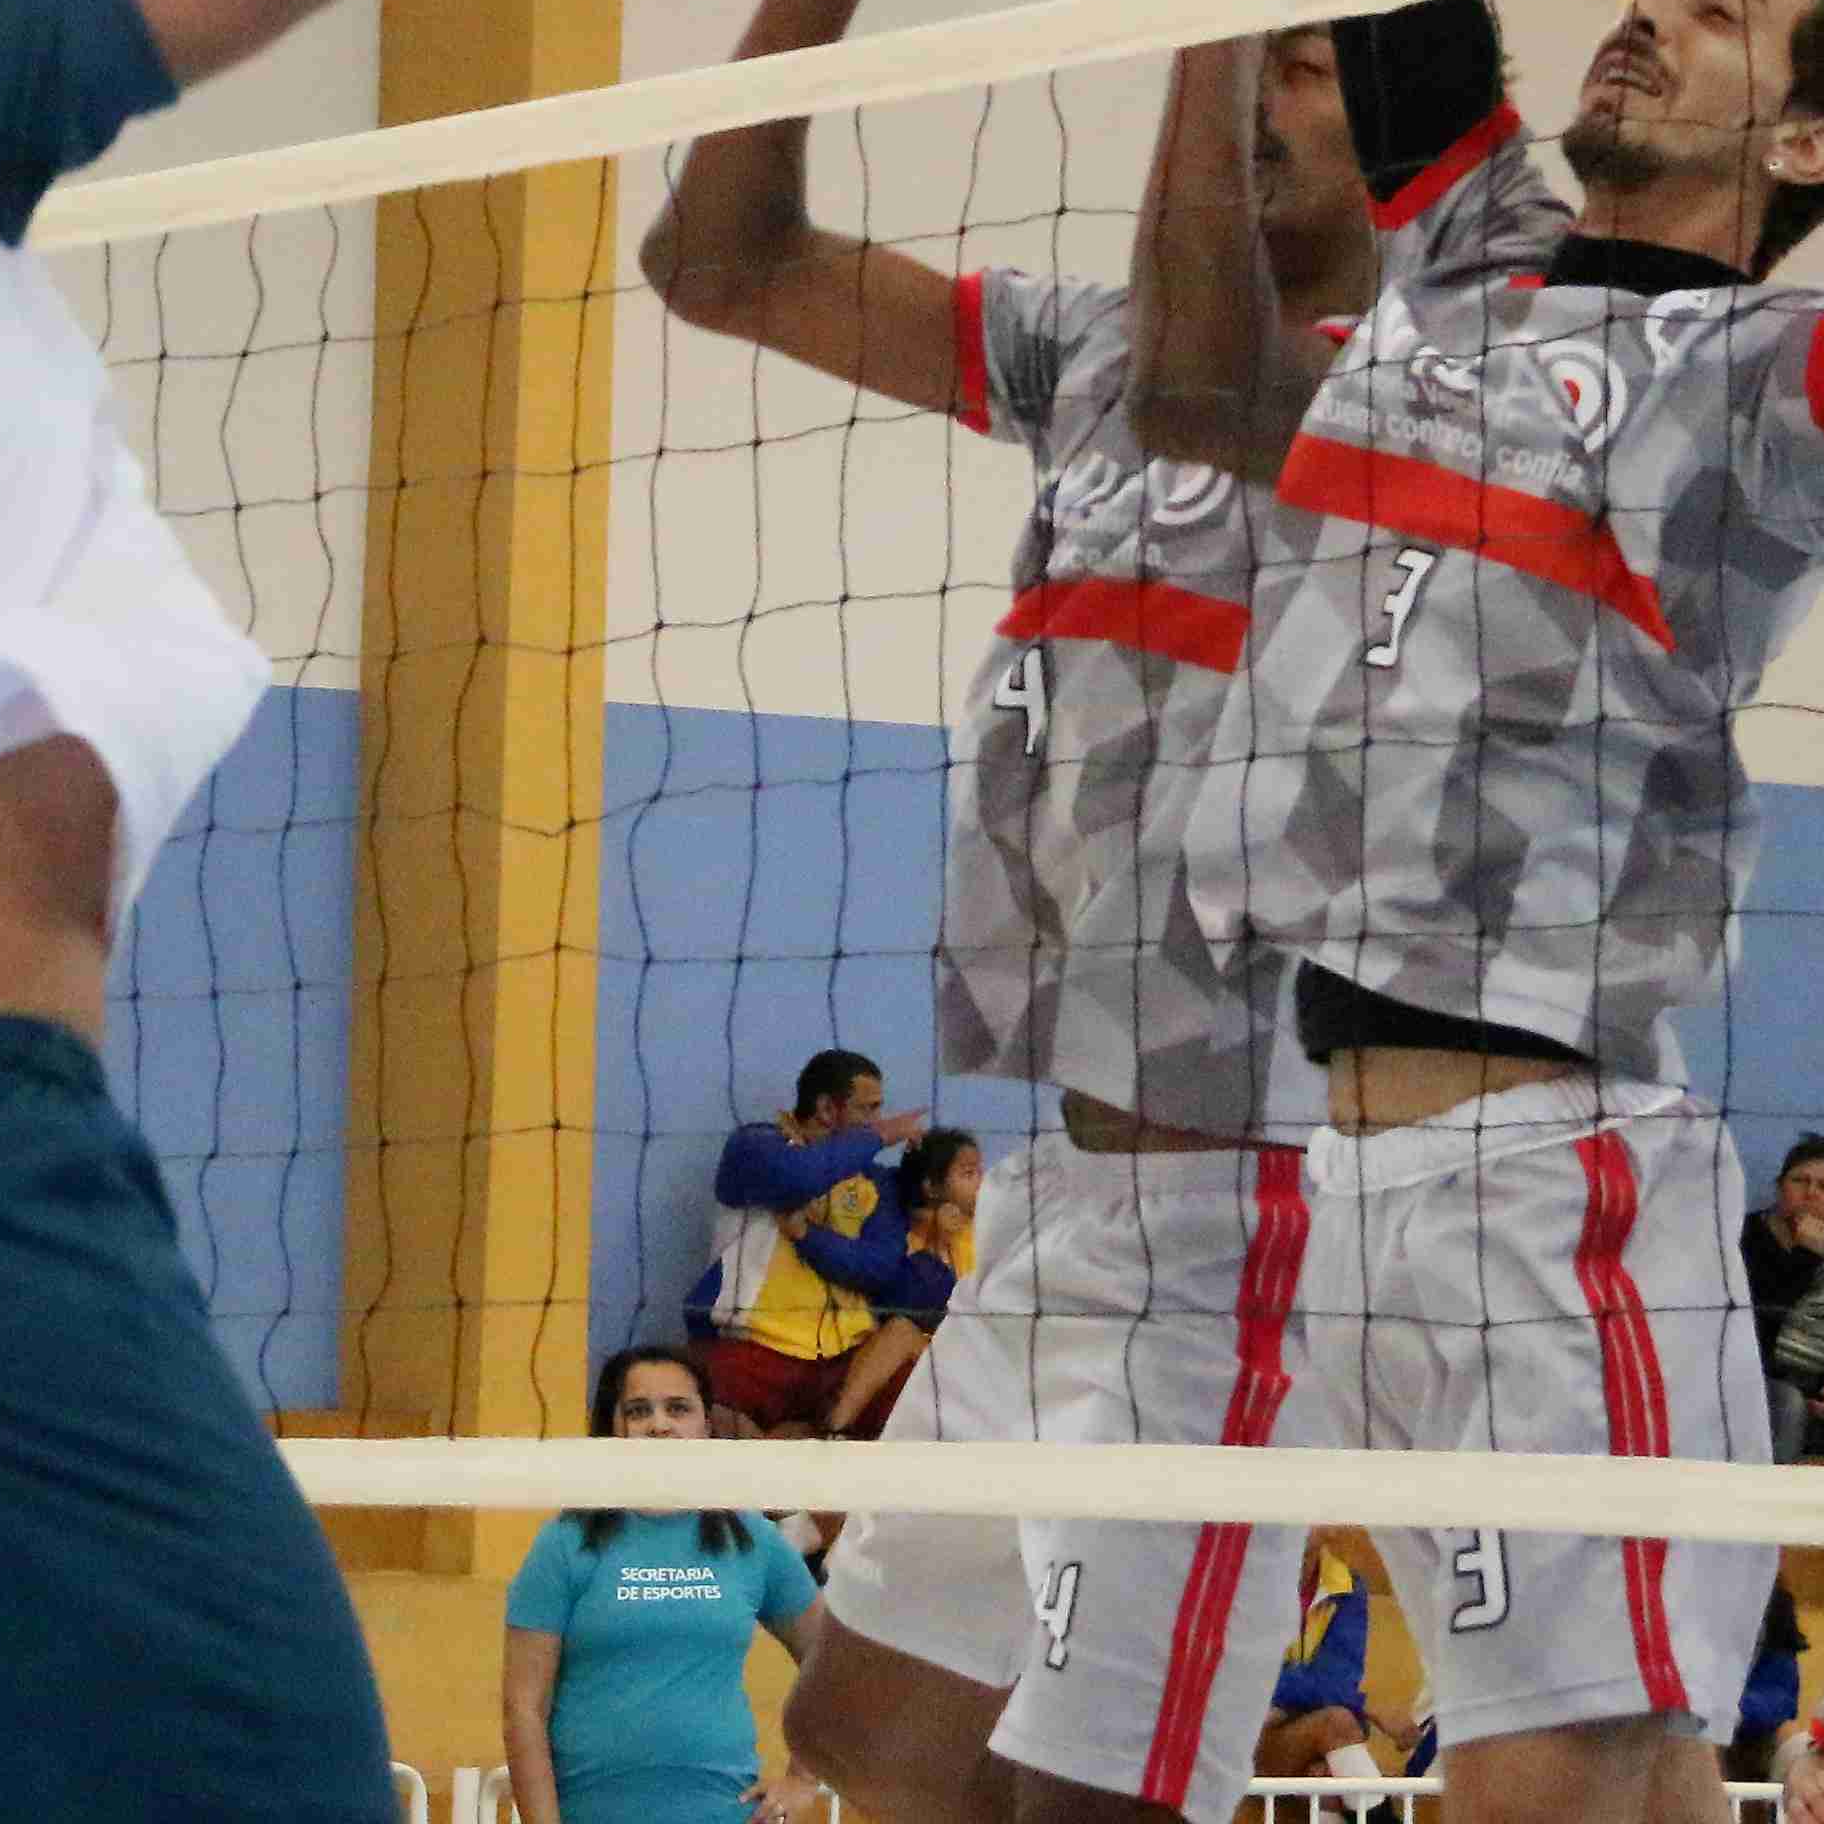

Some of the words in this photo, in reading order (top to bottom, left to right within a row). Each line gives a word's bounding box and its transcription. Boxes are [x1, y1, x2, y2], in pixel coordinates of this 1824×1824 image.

[991, 642, 1051, 756] 4
[620, 1567, 716, 1582] SECRETARIA
[617, 1586, 639, 1601] DE
[643, 1584, 722, 1601] ESPORTES
